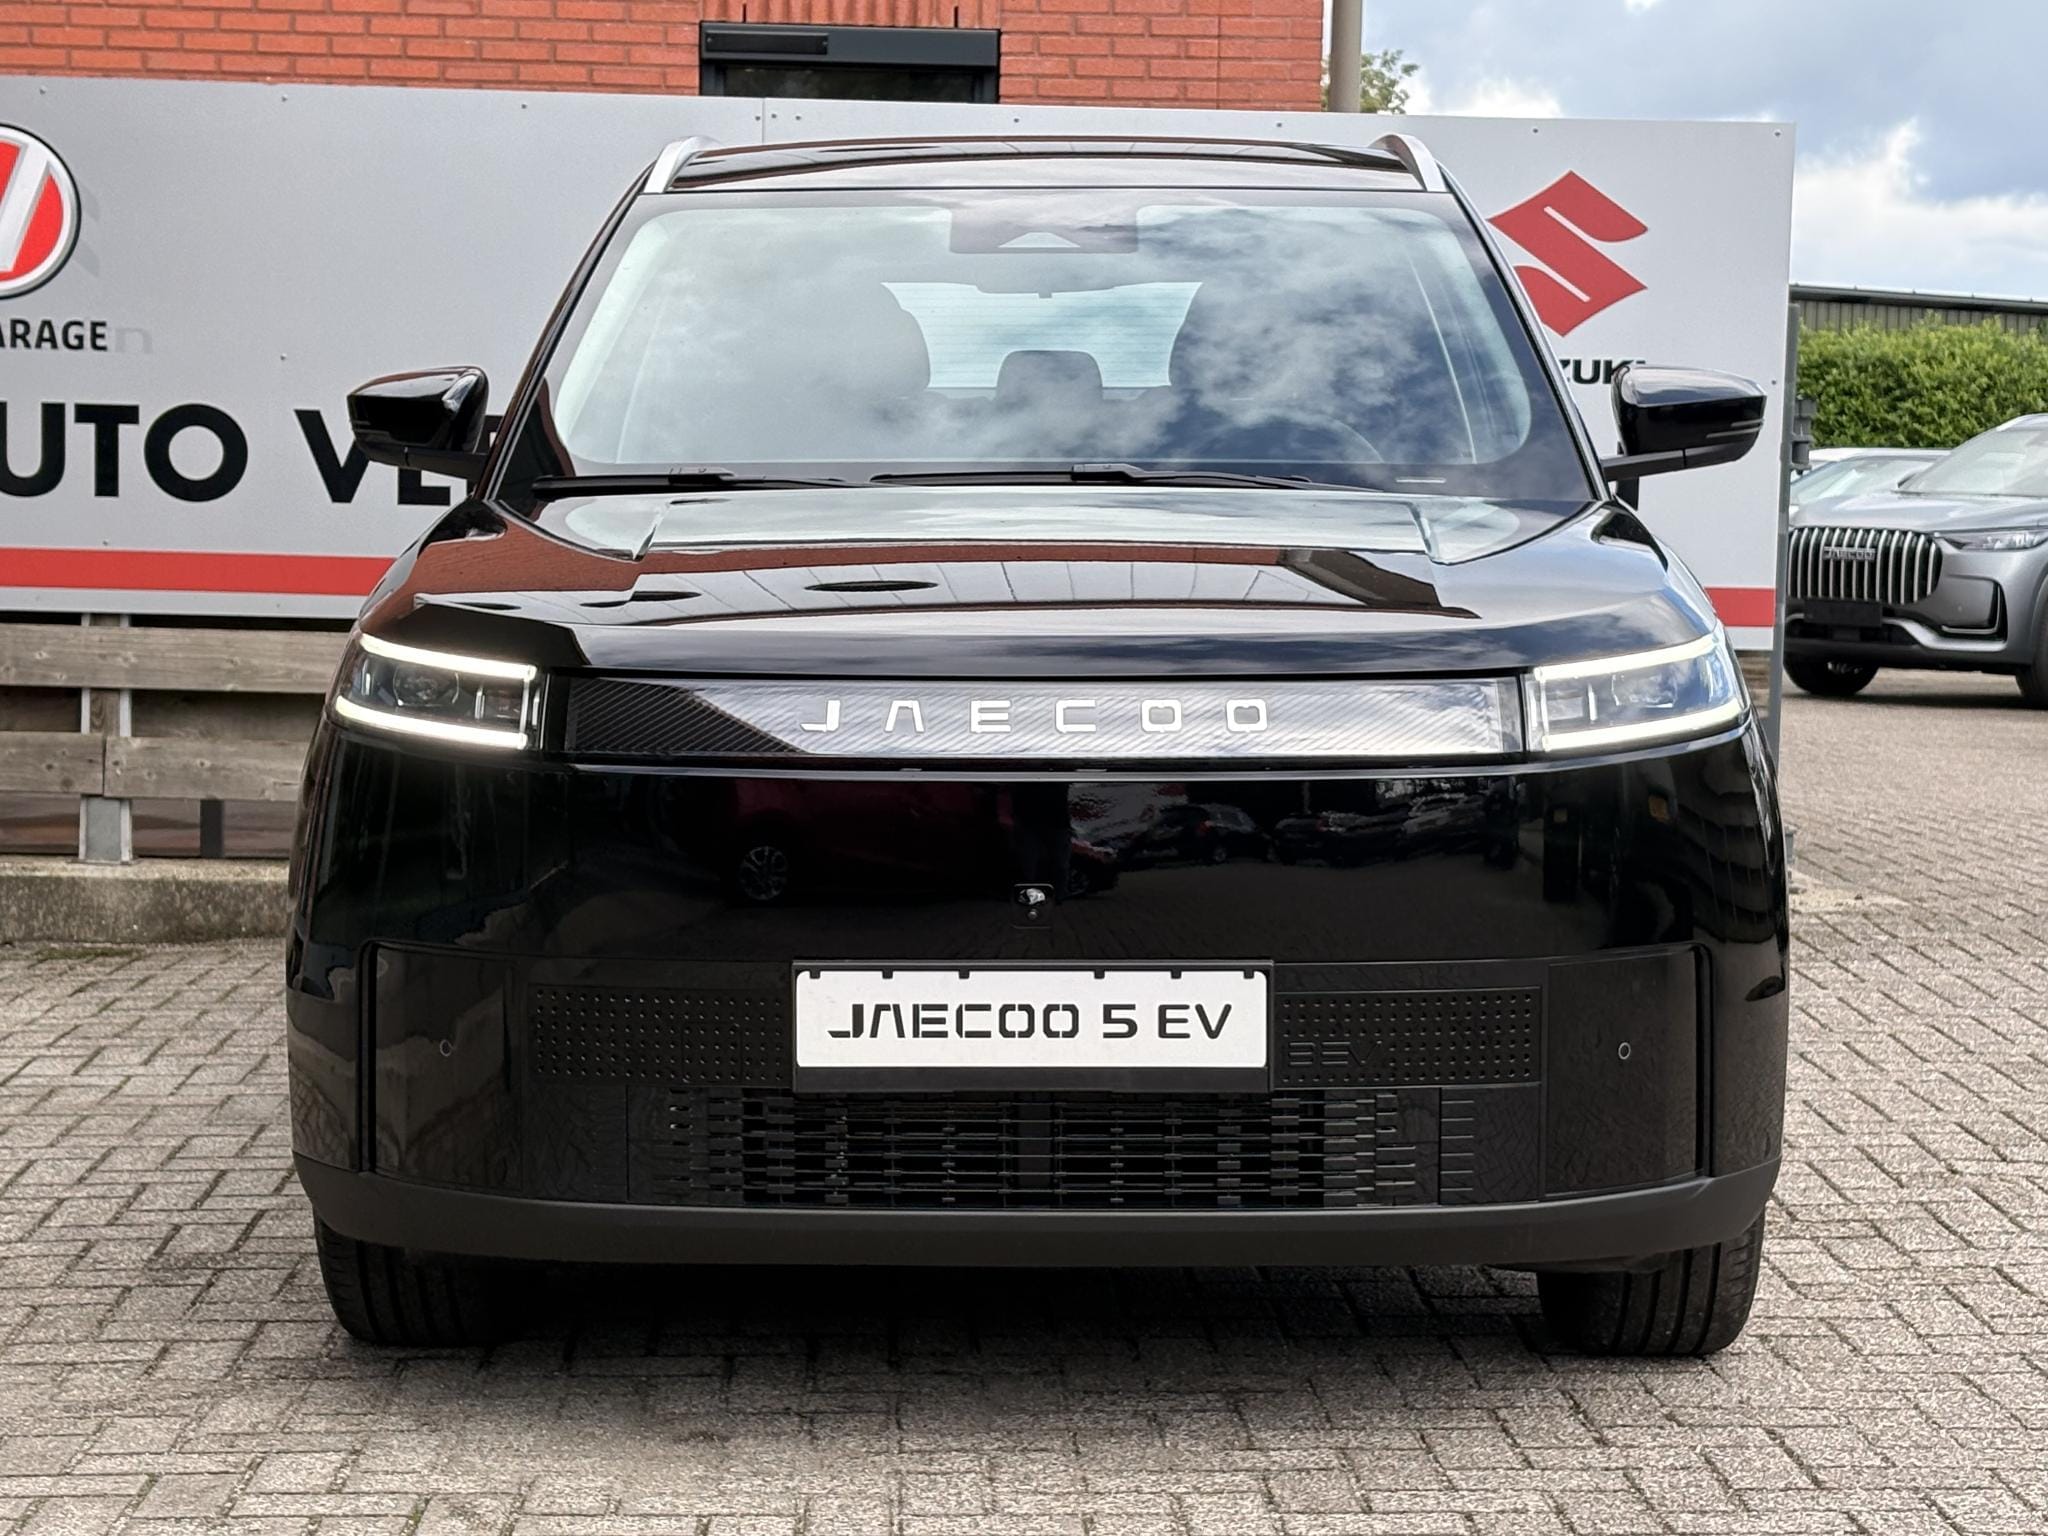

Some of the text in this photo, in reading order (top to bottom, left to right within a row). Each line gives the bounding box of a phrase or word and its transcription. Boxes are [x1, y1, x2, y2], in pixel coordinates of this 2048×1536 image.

[0, 317, 108, 351] RAGE
[801, 698, 1269, 733] JAECOO
[827, 1003, 1232, 1039] JAECOO 5 EV
